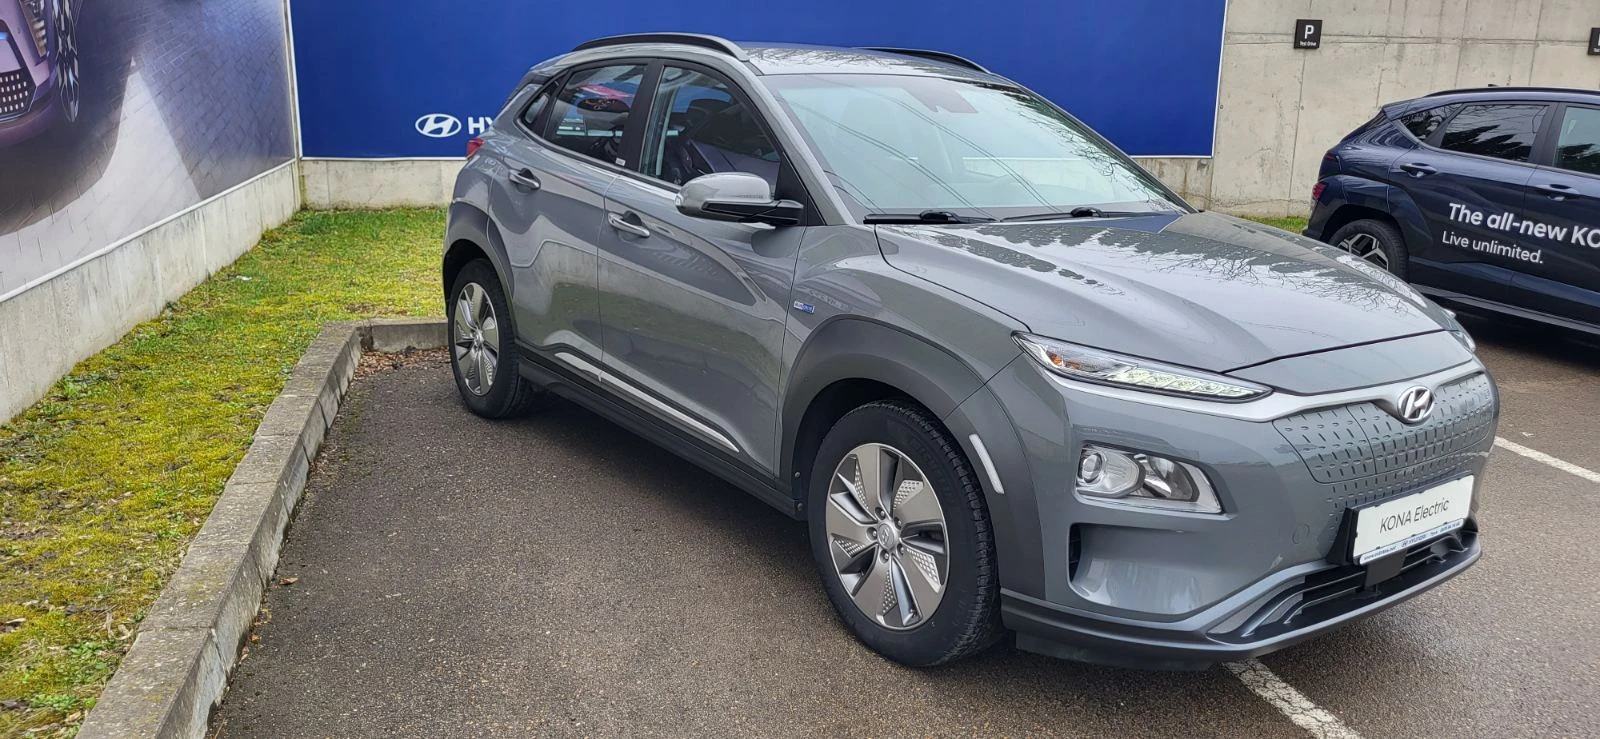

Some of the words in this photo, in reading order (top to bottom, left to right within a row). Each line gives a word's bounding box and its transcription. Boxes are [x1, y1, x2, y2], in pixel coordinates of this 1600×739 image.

[1304, 25, 1314, 39] P
[1449, 203, 1483, 225] The
[1487, 212, 1568, 241] all-new
[1442, 231, 1469, 248] Live
[1472, 240, 1544, 264] unlimited.
[1380, 510, 1412, 534] KONA
[1414, 497, 1450, 522] Electric
